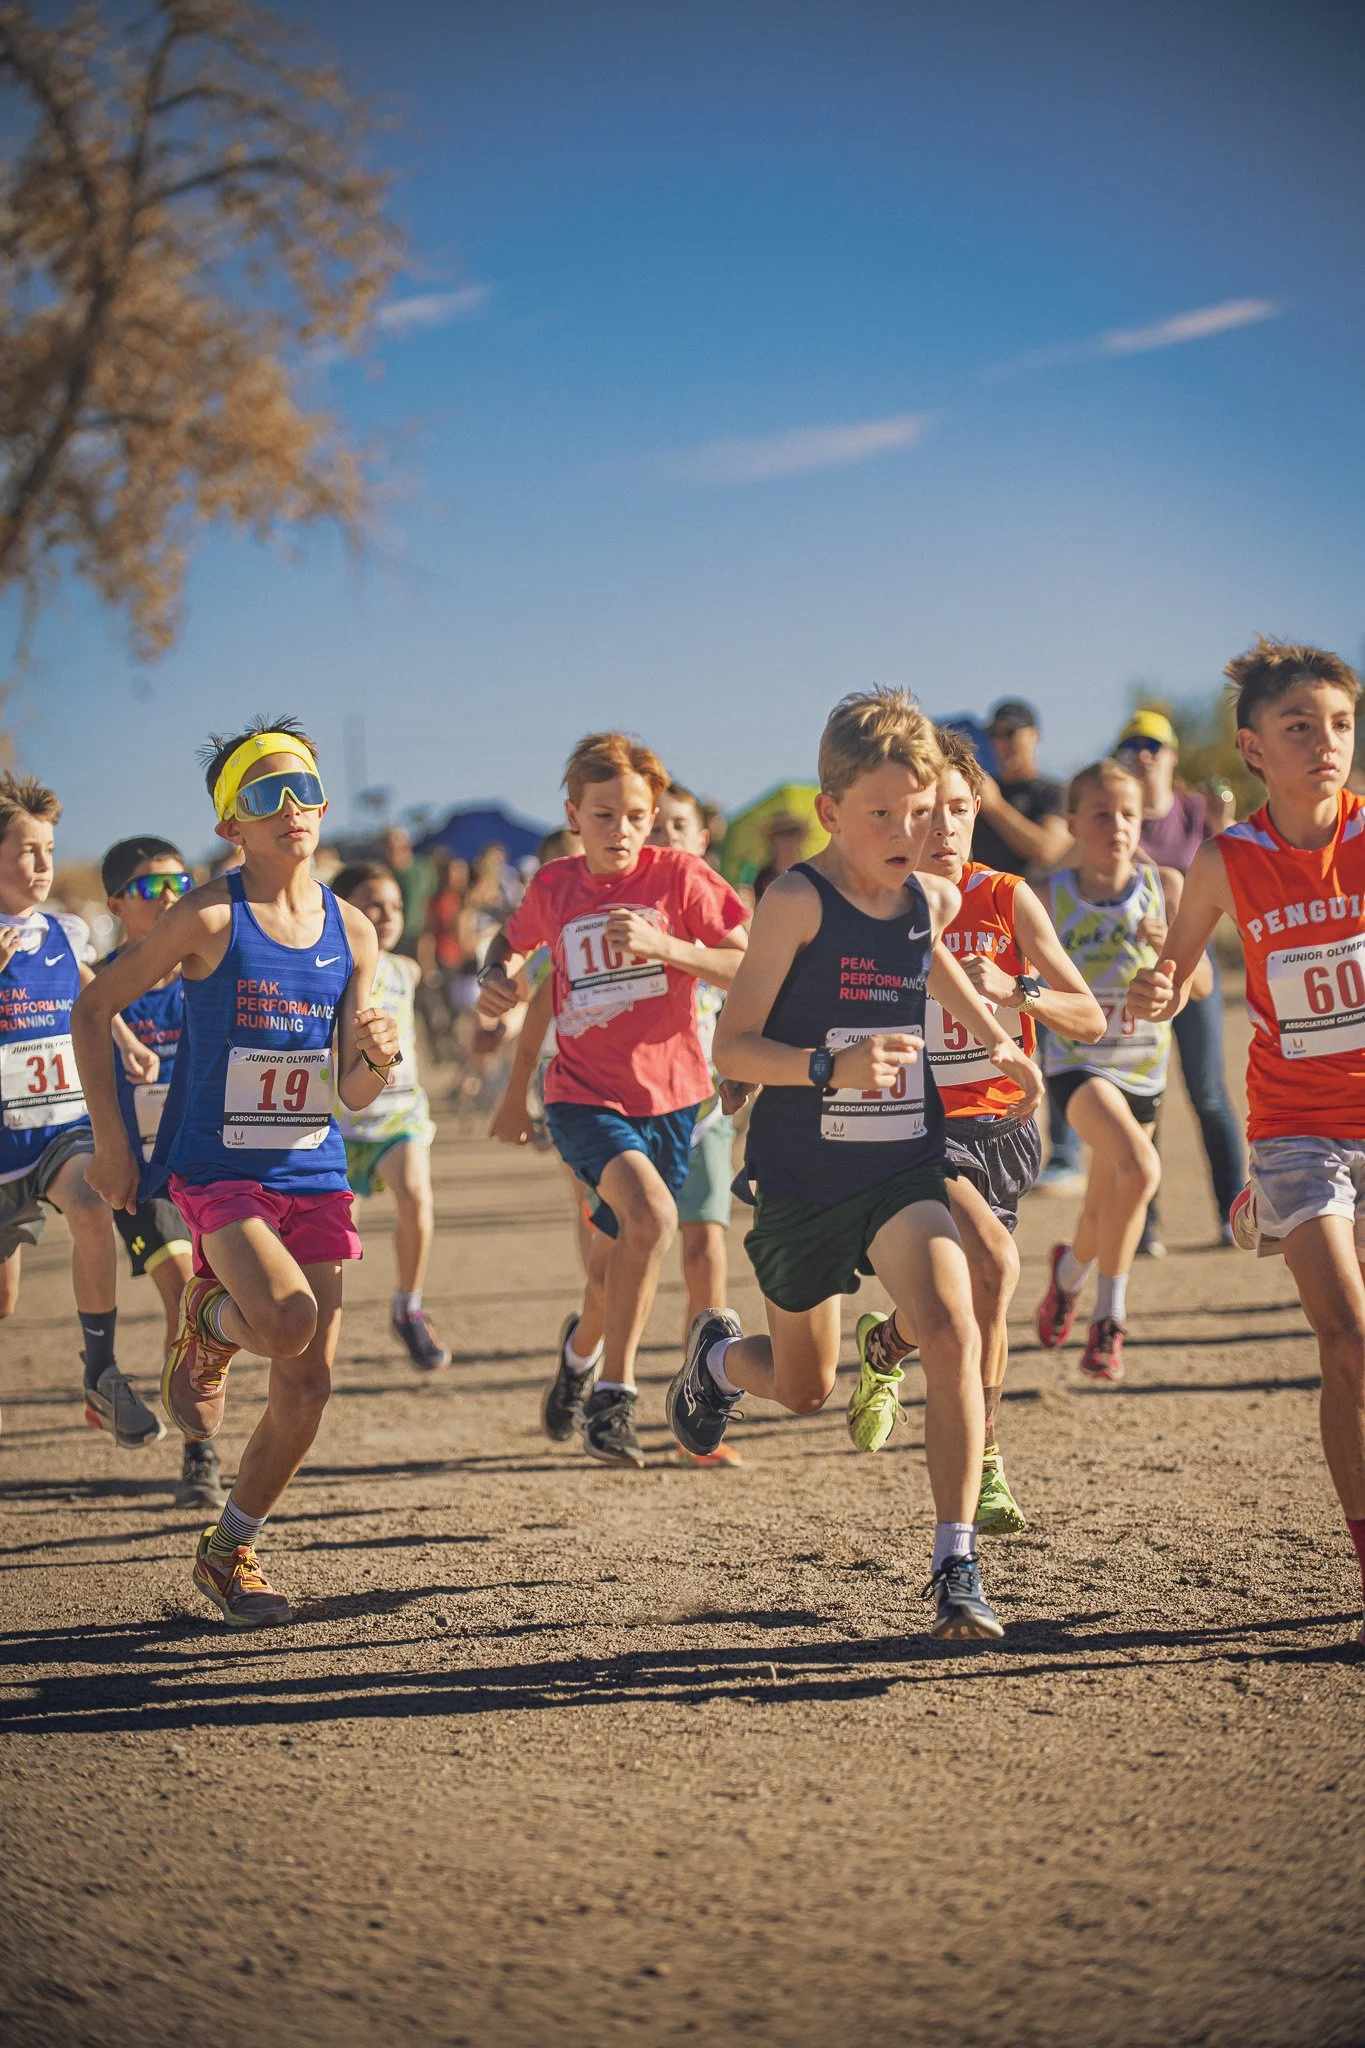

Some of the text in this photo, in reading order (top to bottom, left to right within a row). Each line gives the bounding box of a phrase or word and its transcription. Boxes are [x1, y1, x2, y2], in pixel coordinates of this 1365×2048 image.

[1246, 894, 1365, 943] PENGUI
[944, 931, 1011, 954] UINS
[580, 931, 648, 974] 10
[1282, 951, 1323, 964] JUNIOR
[840, 957, 879, 970] PEAK.
[237, 980, 283, 996] PEAK.
[840, 972, 923, 990] PERFORMANC
[1303, 959, 1365, 1014] 60
[0, 988, 31, 1002] EAK.
[840, 988, 898, 1002] RUNNING
[0, 999, 74, 1016] PERFORMANC
[0, 1013, 55, 1032] RUNNING
[237, 1012, 303, 1032] RUNNING
[1285, 1019, 1336, 1030] ASSOCIATION
[246, 1054, 325, 1064] JUNIOR OLYMPIC
[928, 1053, 966, 1062] SOCIATION
[26, 1053, 70, 1094] 31
[257, 1068, 309, 1111] 19
[861, 1067, 907, 1100] 0
[881, 1101, 924, 1112] CHAMPIONSHIPS
